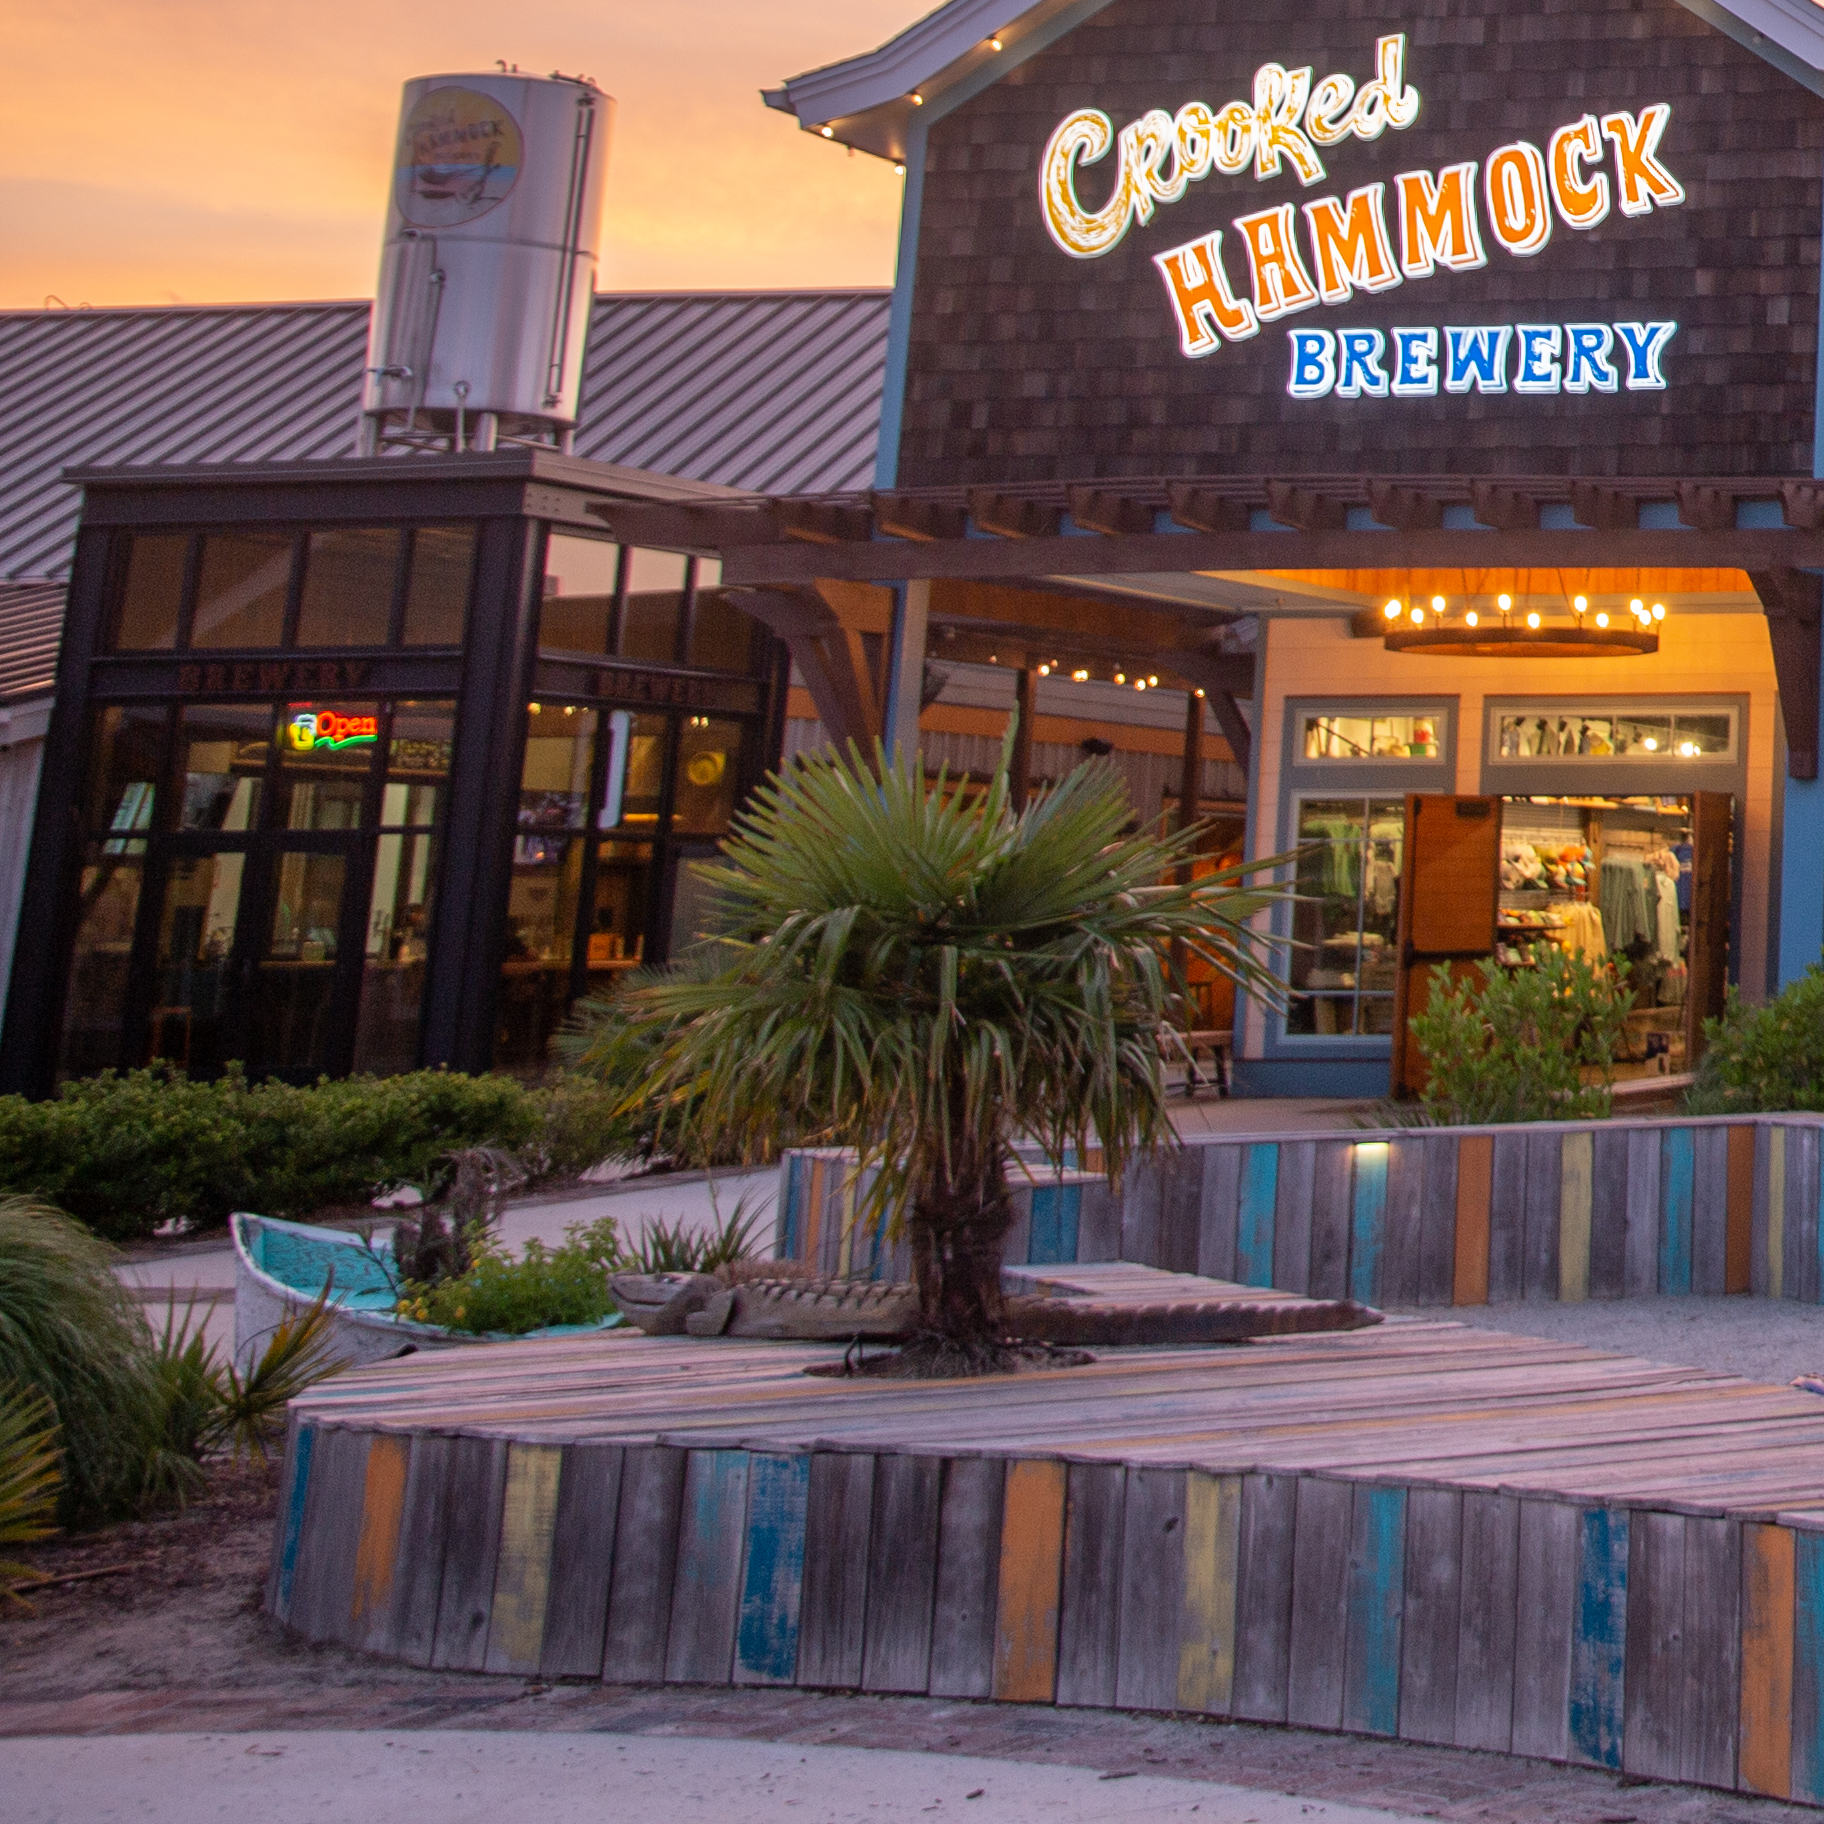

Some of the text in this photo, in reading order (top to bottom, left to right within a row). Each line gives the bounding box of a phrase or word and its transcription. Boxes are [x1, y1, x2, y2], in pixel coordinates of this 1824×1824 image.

[1152, 103, 1686, 357] HAMMOCK
[1287, 321, 1678, 399] BREWERY
[177, 660, 372, 691] BREWERY
[316, 710, 378, 742] Open
